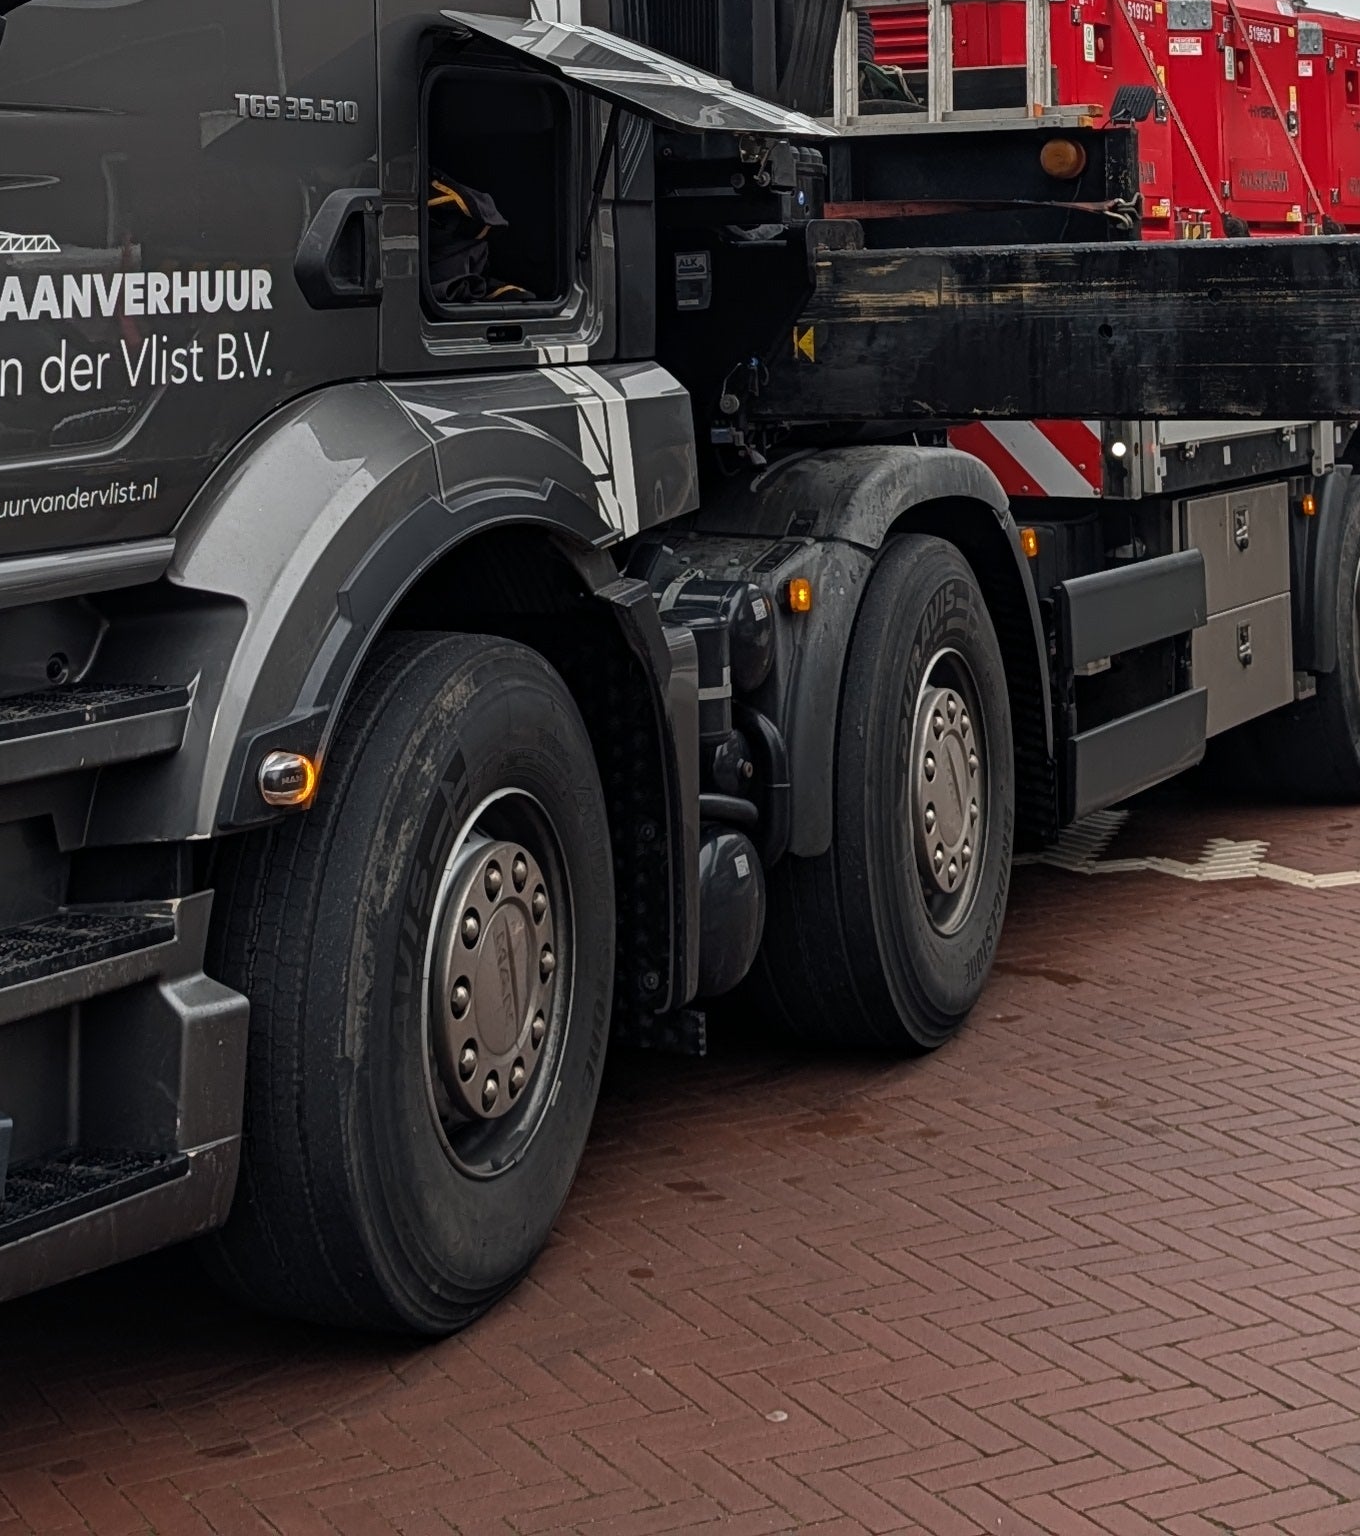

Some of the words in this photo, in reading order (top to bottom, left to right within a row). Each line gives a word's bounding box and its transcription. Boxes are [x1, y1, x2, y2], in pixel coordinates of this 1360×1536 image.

[1126, 0, 1153, 22] 519731
[234, 93, 280, 119] TGS
[285, 96, 359, 124] 35.510
[40, 338, 111, 394] der
[120, 333, 204, 387] Vlist
[217, 330, 273, 381] B.V.
[281, 775, 303, 785] MAN
